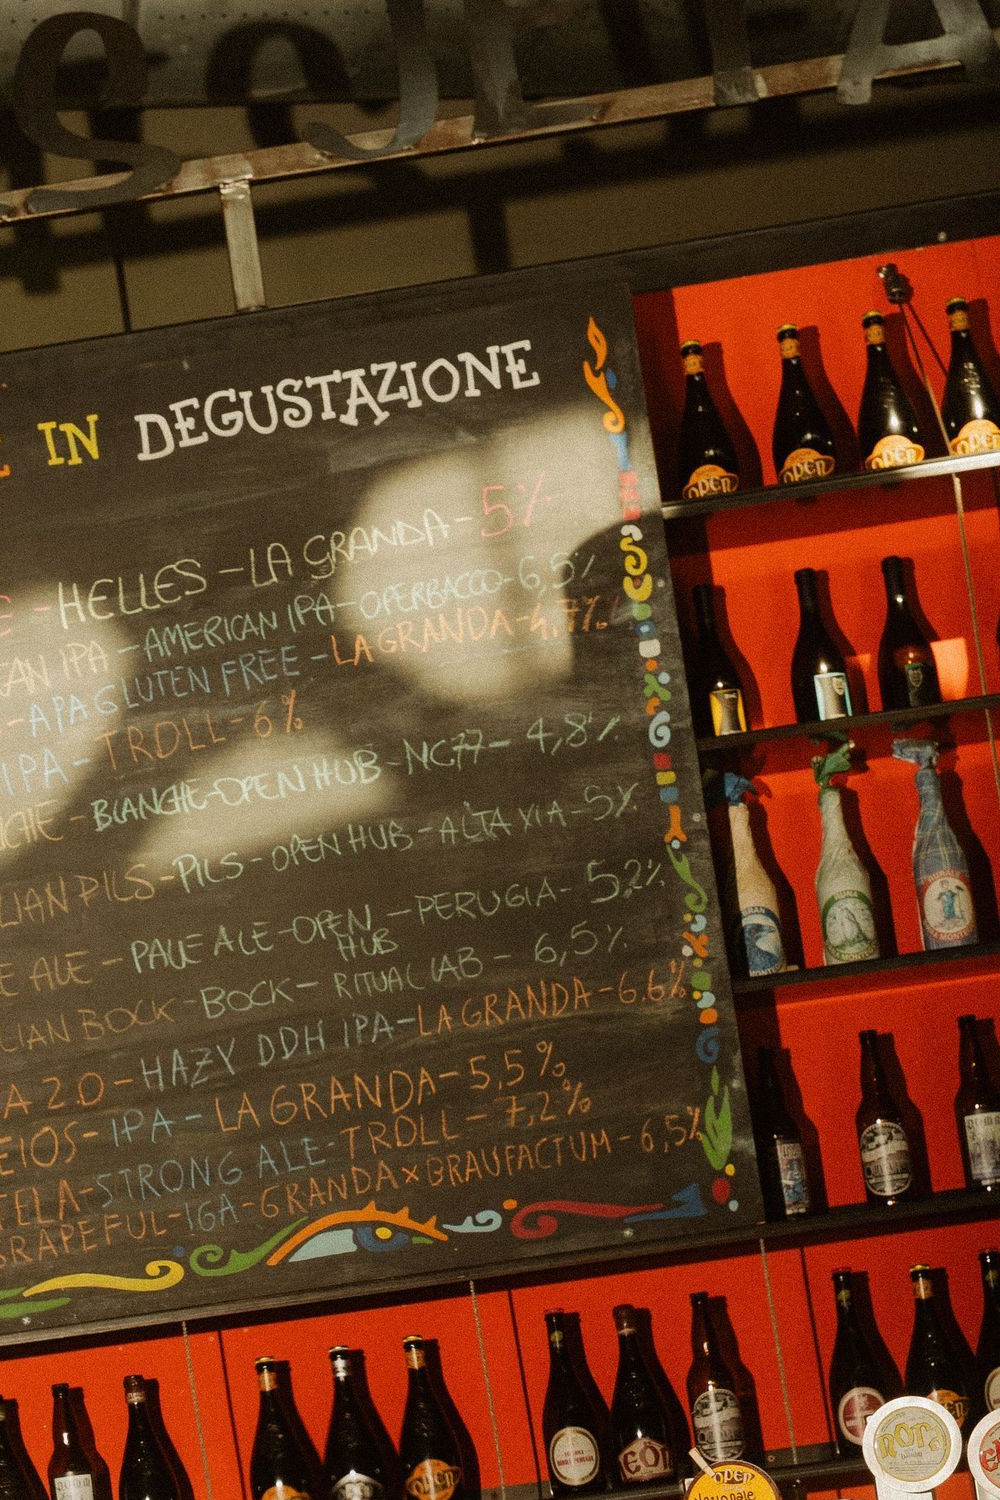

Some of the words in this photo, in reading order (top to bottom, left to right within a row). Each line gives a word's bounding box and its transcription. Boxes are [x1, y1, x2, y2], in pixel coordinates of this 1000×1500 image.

[37, 414, 100, 466] IN
[134, 339, 540, 461] DEGUSTAZIONE
[58, 559, 208, 629] HELLES
[249, 542, 294, 588] LA
[303, 508, 450, 579] GRANDA
[29, 694, 90, 737] APA
[95, 665, 211, 714] GLUTEN
[221, 645, 300, 697] FREE
[331, 633, 373, 666] LA
[379, 604, 514, 653] GRANDA
[59, 640, 109, 680] IPA
[144, 607, 279, 662] AMERICAN
[288, 592, 336, 634] IPA
[2, 749, 70, 796] IPA
[96, 714, 225, 770] TROLL
[312, 749, 381, 790] HUB
[74, 863, 155, 905] PILS
[172, 852, 243, 893] PILS
[272, 832, 341, 871] OPEN
[348, 819, 413, 852] HUB
[30, 951, 93, 992] ALE
[131, 933, 203, 973] PALE
[214, 921, 274, 956] ALE
[293, 904, 371, 944] OPEN
[414, 876, 556, 924] PERUGIA
[337, 928, 399, 962] HUB
[77, 998, 175, 1040] BOCK
[200, 978, 294, 1019] BOCK
[334, 963, 425, 999] RITUAL
[431, 946, 483, 982] LAB
[141, 1038, 235, 1092] HAZY
[258, 1019, 325, 1067] DDH
[343, 1011, 394, 1048] IPA
[418, 1004, 452, 1037] LA
[462, 976, 592, 1028] GRANDA
[113, 1108, 174, 1147] IPA
[215, 1091, 261, 1133] LA
[270, 1066, 436, 1125] GRANDA
[96, 1150, 243, 1208] STRONG
[258, 1137, 326, 1179] ALE
[340, 1109, 460, 1160] TROLL
[186, 1193, 240, 1232] IGA
[260, 1160, 399, 1218] GRANDA
[427, 1128, 612, 1187] BRAUFACTUM
